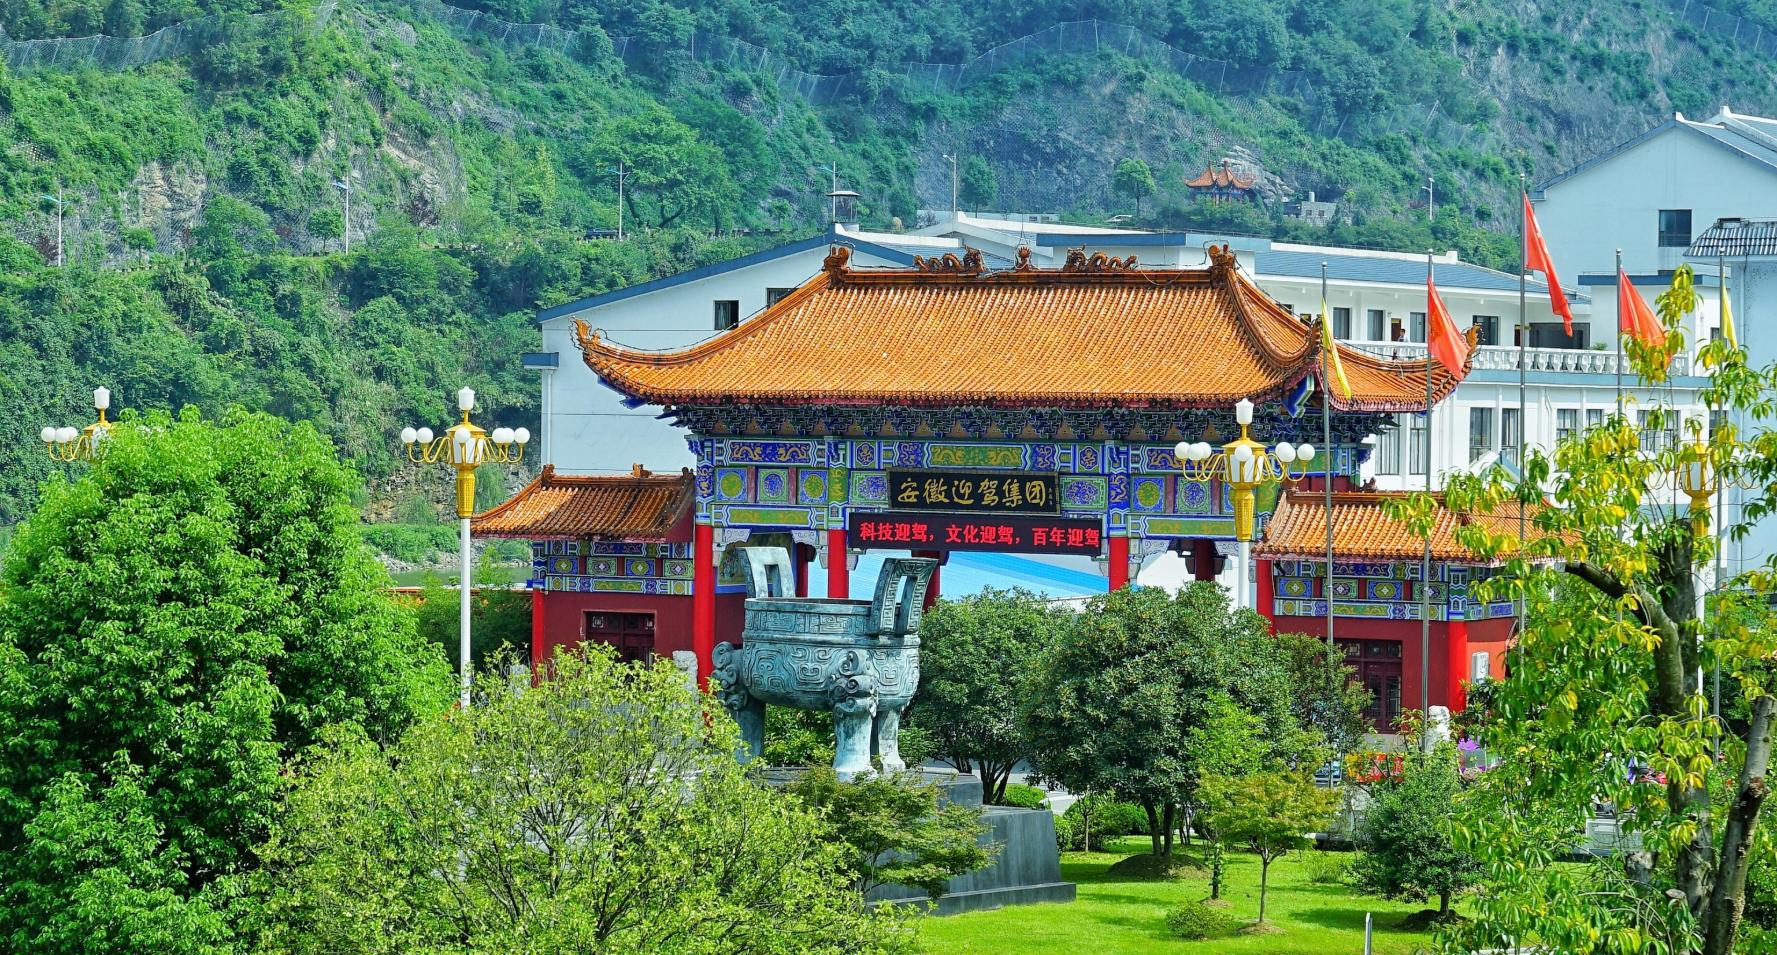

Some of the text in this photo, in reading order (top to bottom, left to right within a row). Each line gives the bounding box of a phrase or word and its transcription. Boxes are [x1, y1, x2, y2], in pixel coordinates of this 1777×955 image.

[898, 478, 1046, 507] 安徽迎驾集团
